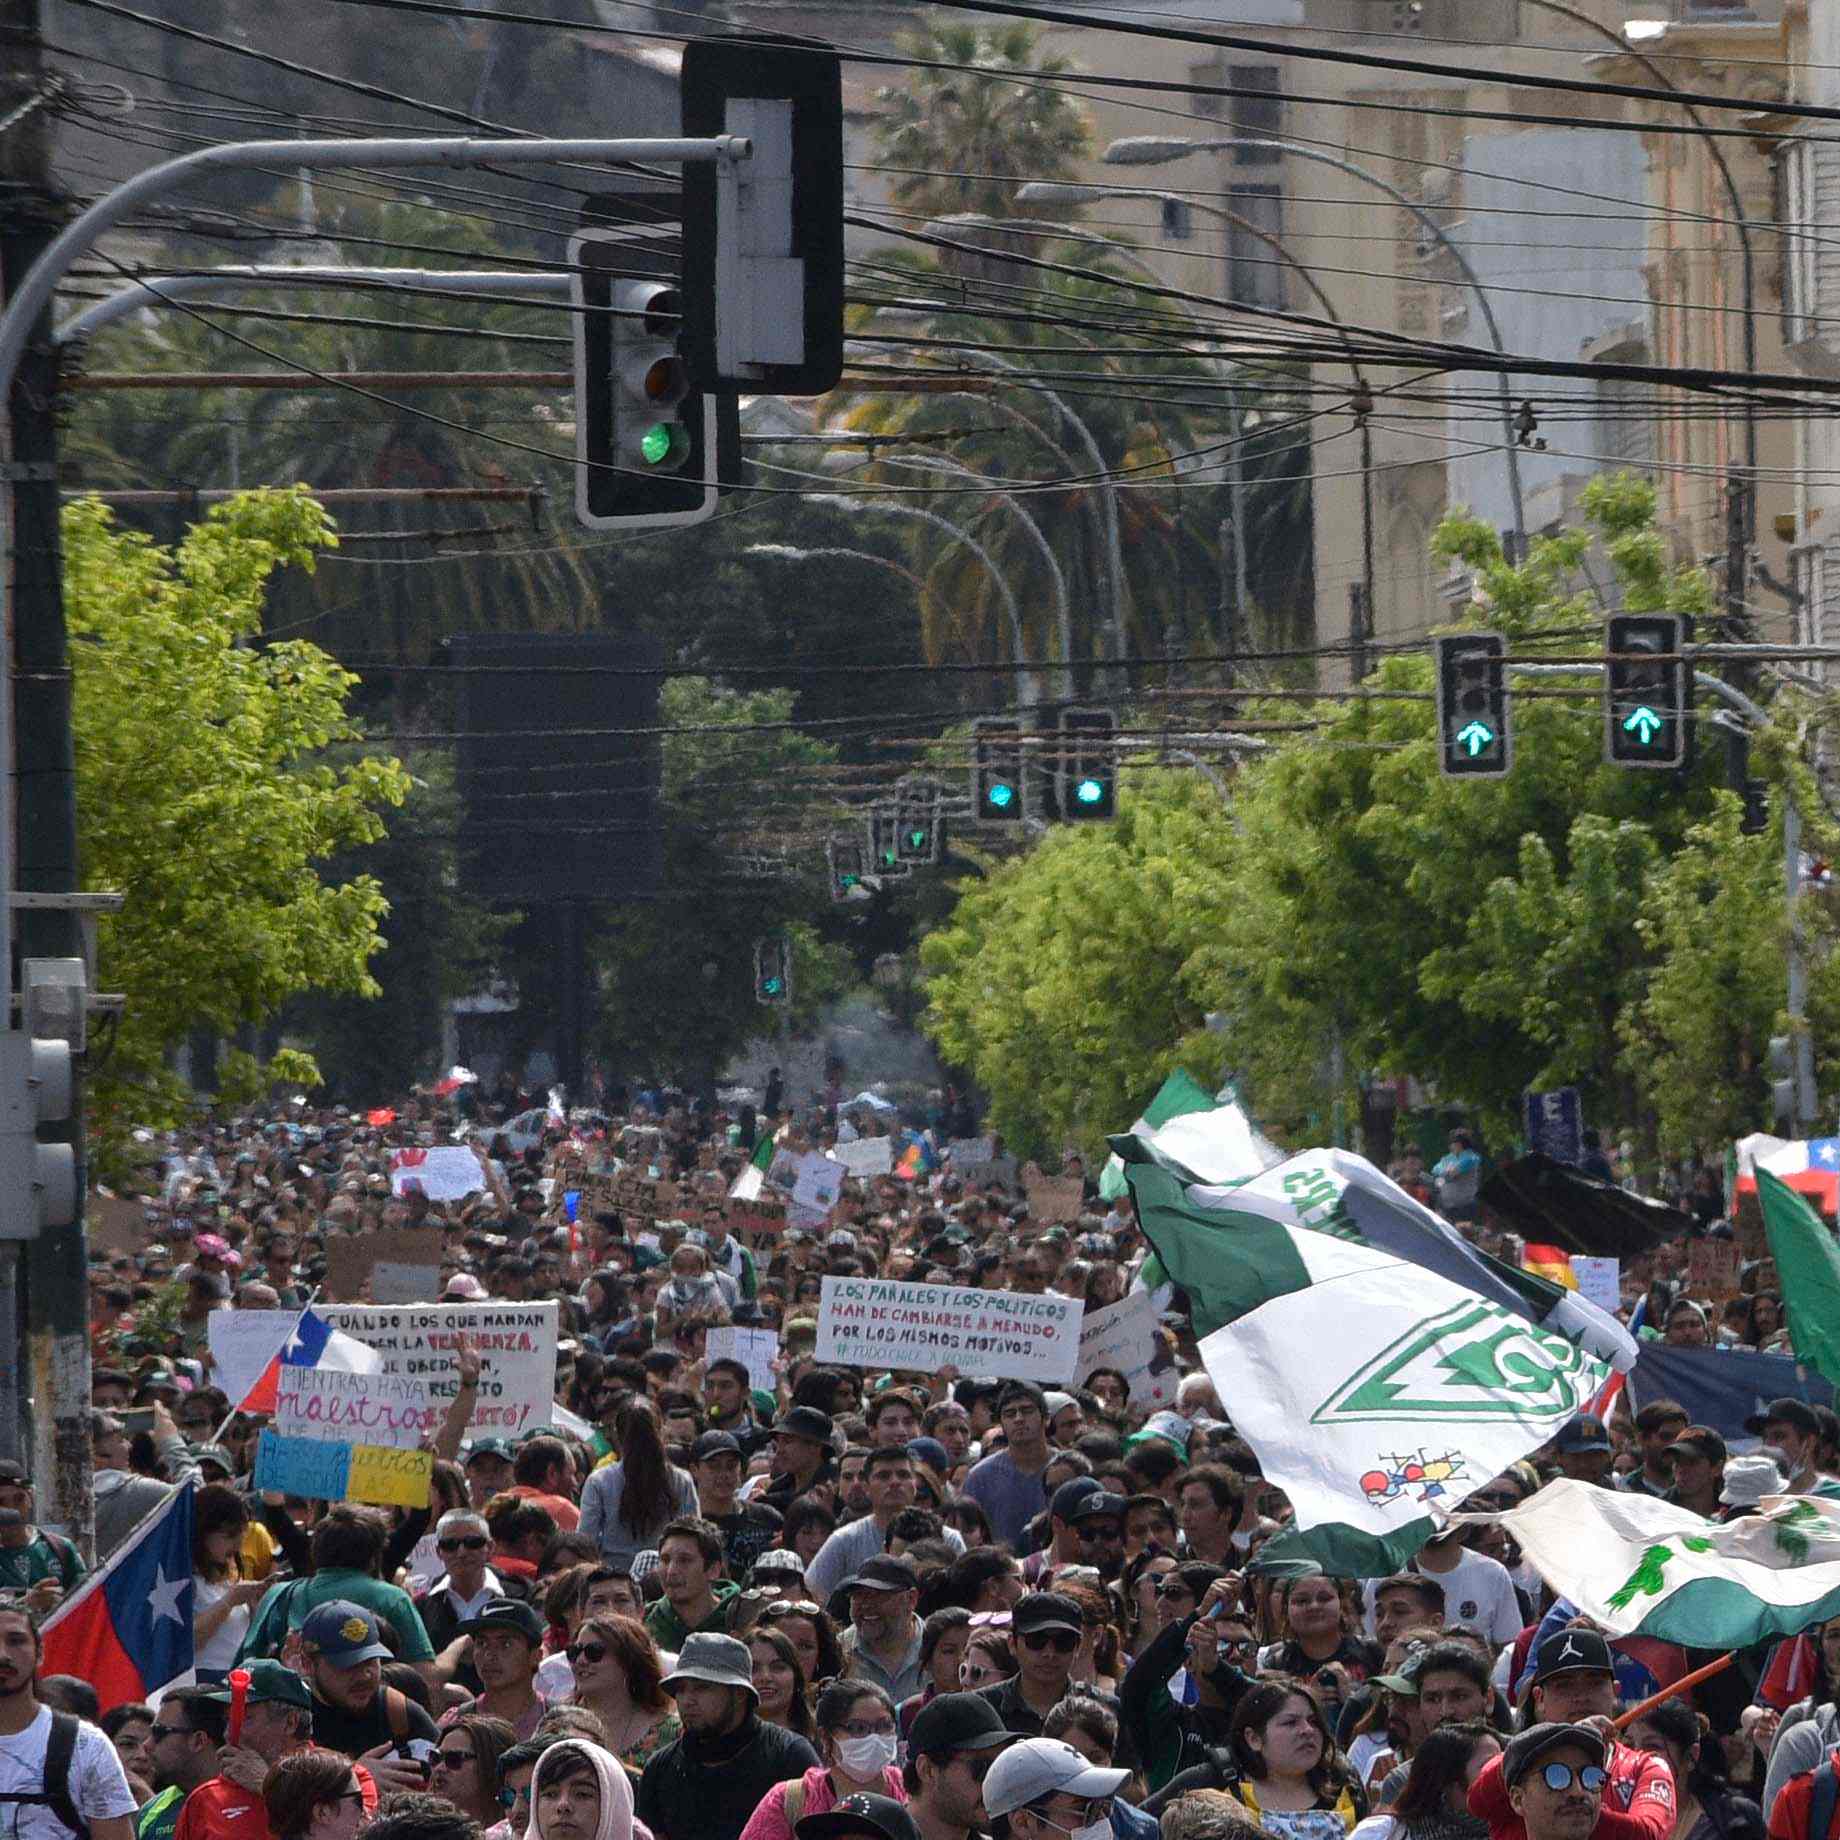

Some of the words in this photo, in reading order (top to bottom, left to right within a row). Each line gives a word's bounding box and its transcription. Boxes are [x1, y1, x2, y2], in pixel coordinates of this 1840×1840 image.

[834, 1285, 863, 1299] LOS
[867, 1284, 935, 1304] PAÑALES
[940, 1292, 951, 1305] Y
[954, 1294, 984, 1308] LOS
[413, 1314, 439, 1329] LOS
[445, 1314, 478, 1330] QUE
[484, 1314, 545, 1329] MANDAN
[831, 1303, 865, 1317] HAN
[872, 1307, 887, 1320] DE
[891, 1310, 971, 1329] CAMBIARSE
[976, 1316, 988, 1331] A
[404, 1336, 424, 1351] LA
[833, 1325, 860, 1338] POR
[866, 1327, 896, 1342] LOS
[899, 1329, 961, 1349] MISMOS
